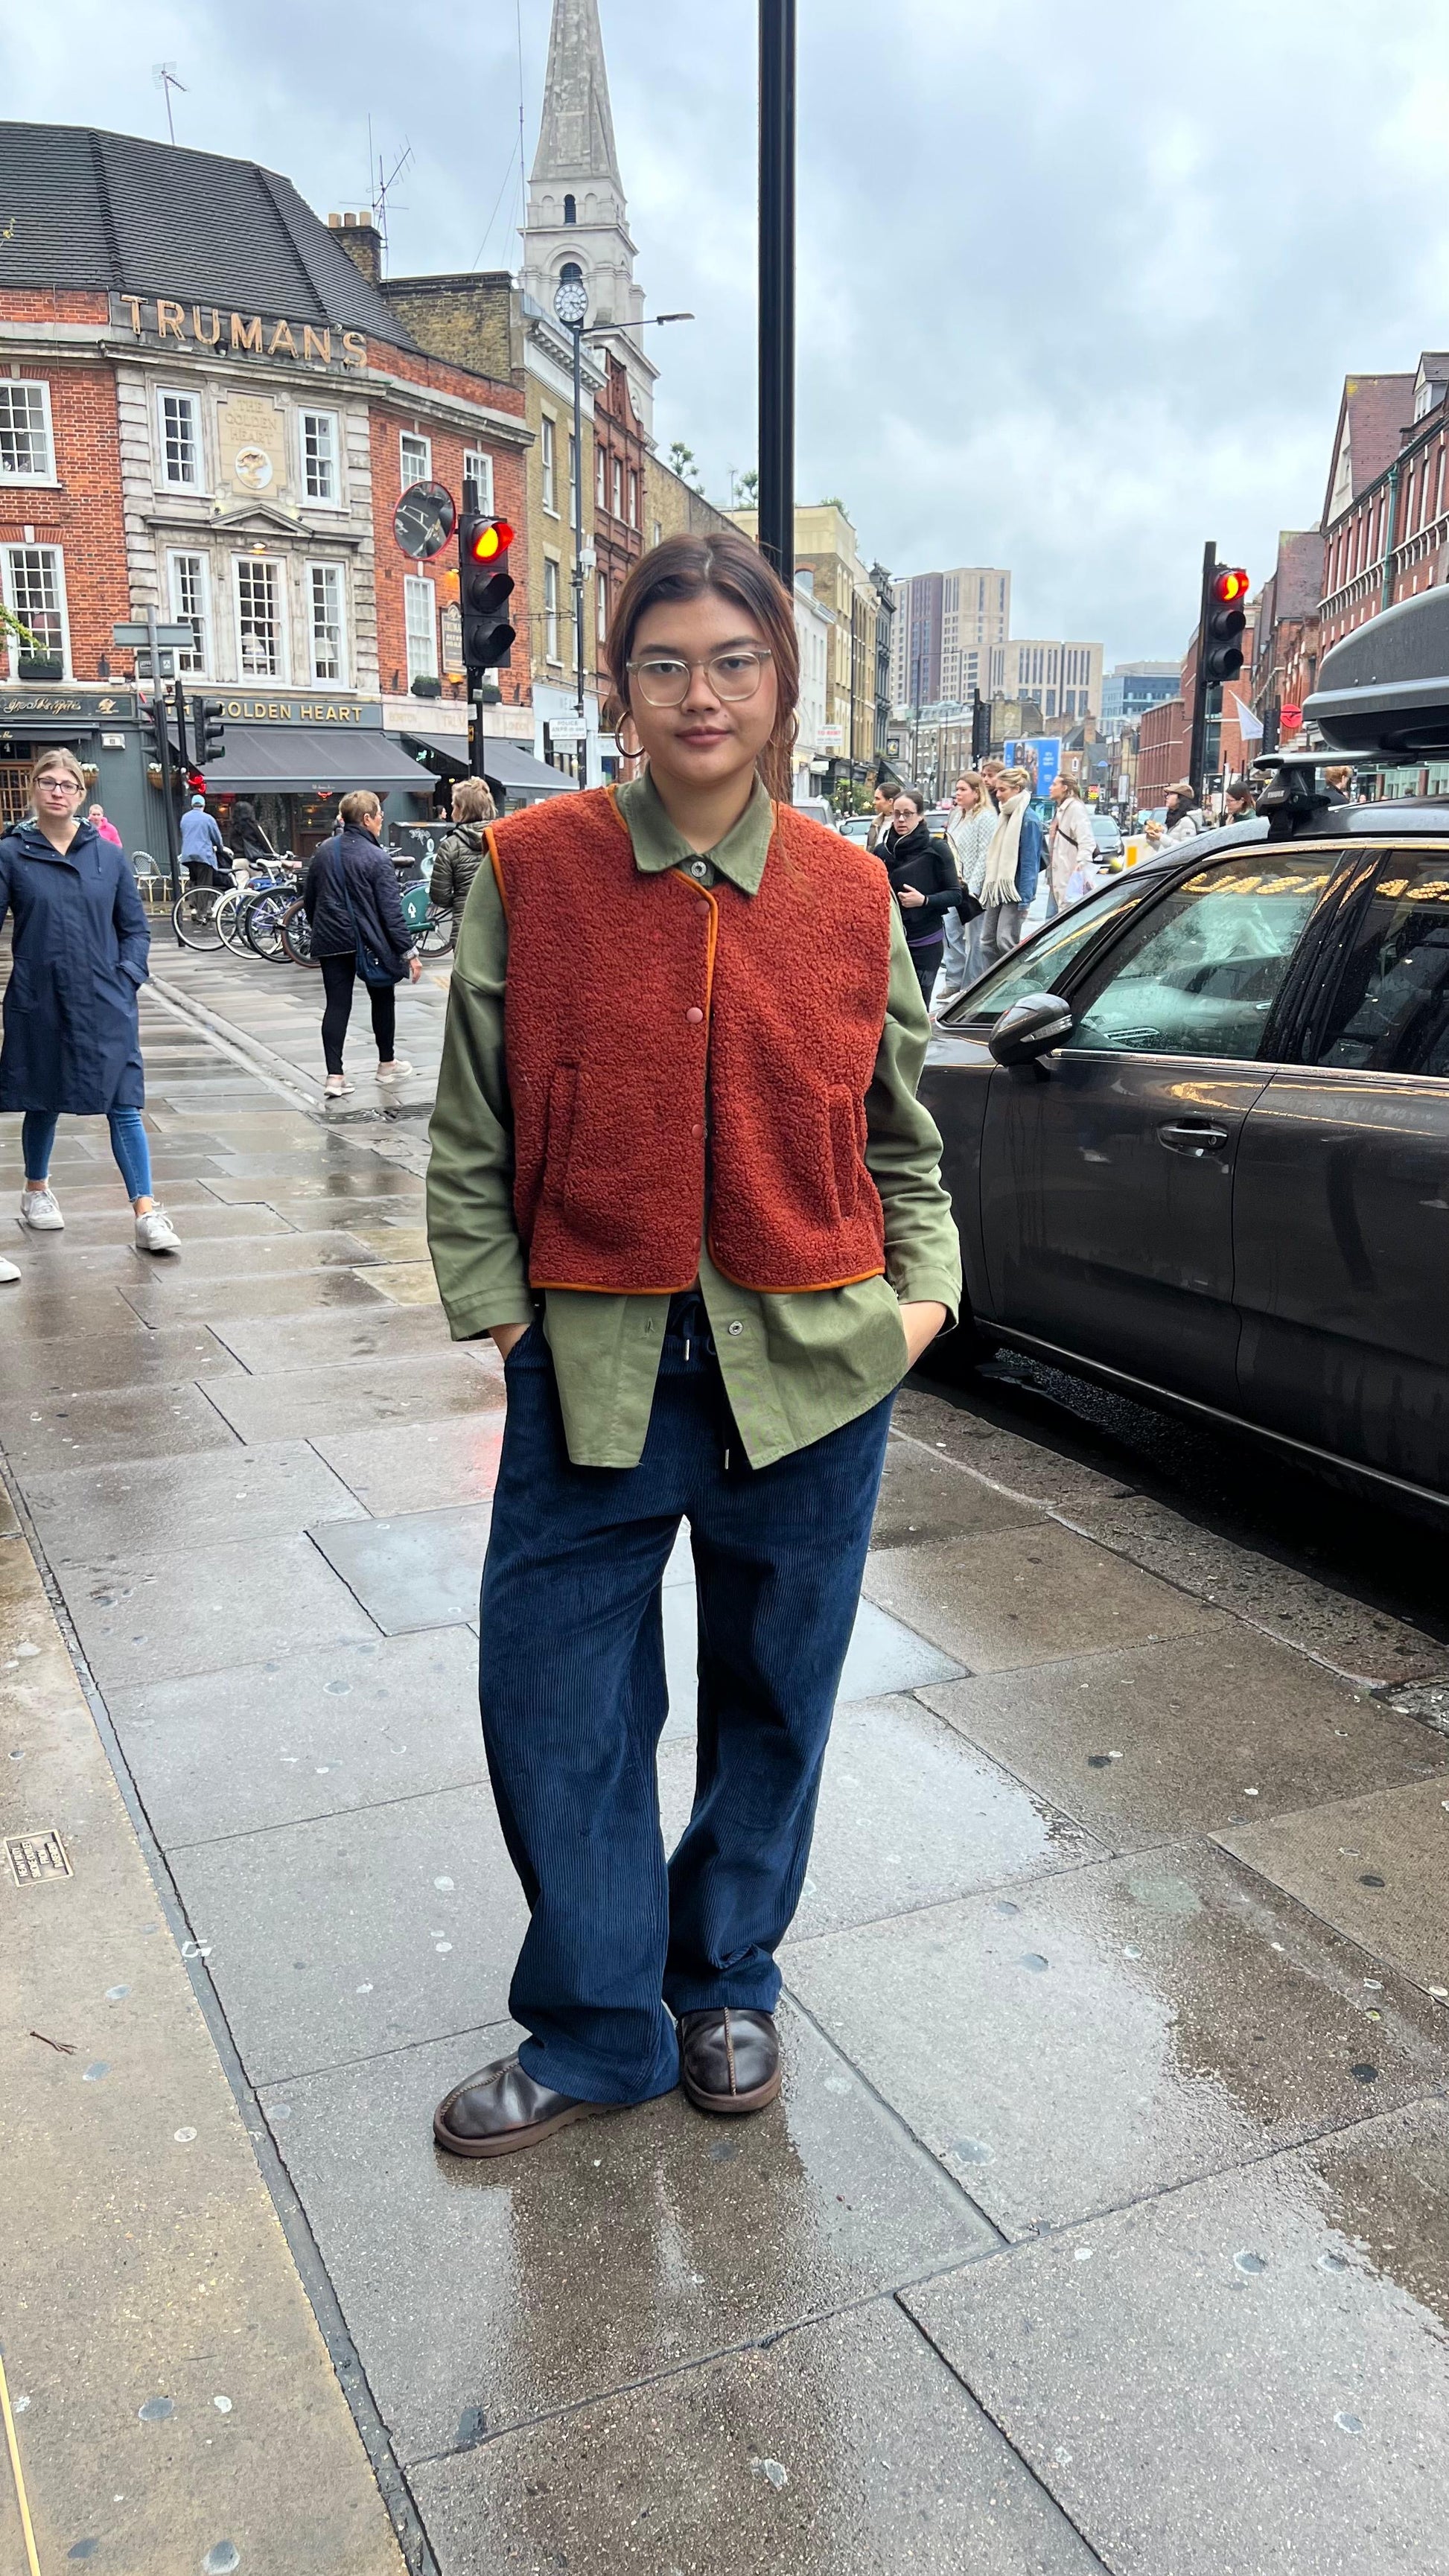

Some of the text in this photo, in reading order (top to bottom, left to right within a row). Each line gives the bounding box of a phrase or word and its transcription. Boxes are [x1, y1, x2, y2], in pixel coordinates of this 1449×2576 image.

[121, 294, 368, 369] TRUMAN'S
[237, 399, 264, 413] THE
[226, 413, 277, 430] GOLDEN
[231, 429, 273, 444] HEART
[301, 705, 363, 723] HEART
[4, 742, 10, 753] 4
[37, 1849, 50, 1864] FROM
[15, 1861, 29, 1877] HEAVY
